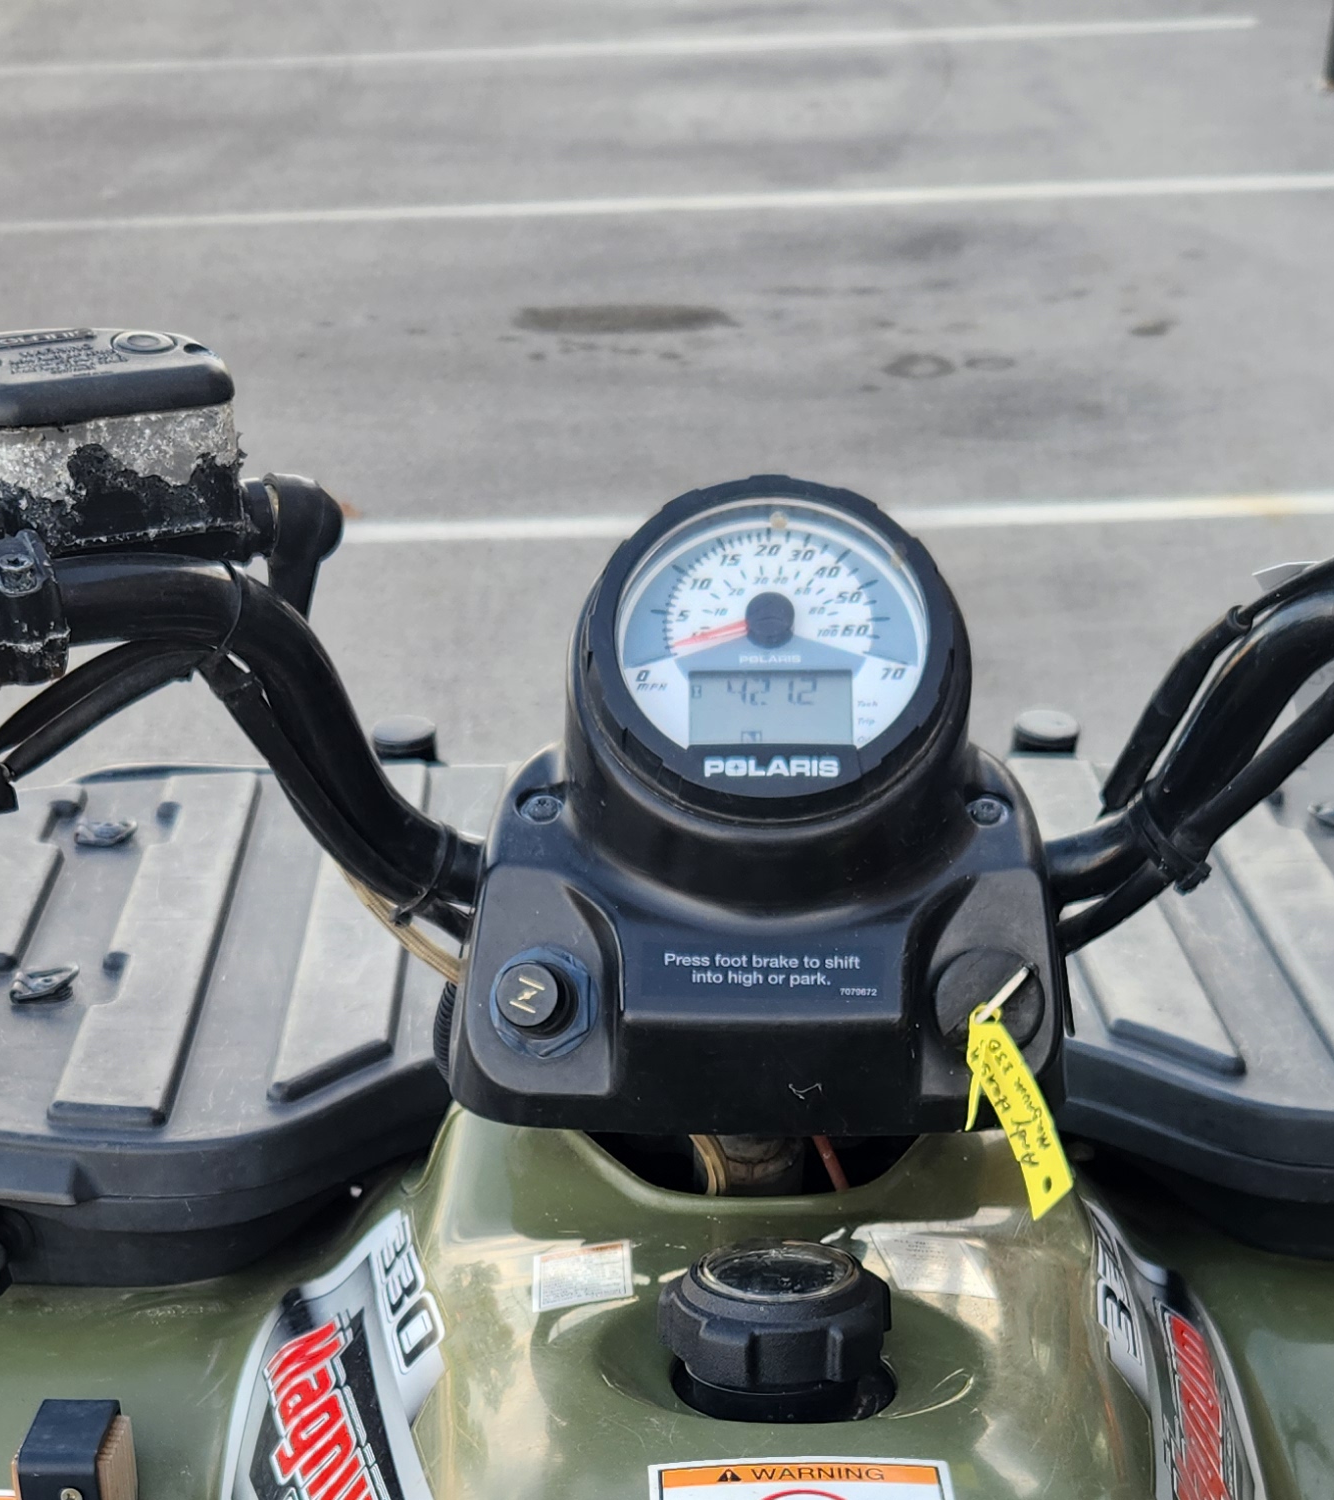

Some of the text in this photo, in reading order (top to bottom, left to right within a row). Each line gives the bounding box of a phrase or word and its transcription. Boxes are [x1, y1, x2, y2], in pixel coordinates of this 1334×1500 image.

[754, 545, 781, 556] 20
[789, 550, 815, 561] 30
[720, 554, 741, 566] 15
[815, 567, 840, 578] 40
[690, 578, 712, 590] 10
[835, 592, 862, 603] 50
[676, 611, 690, 622] 5
[841, 625, 869, 637] 60
[739, 654, 802, 664] POLARIS
[636, 670, 650, 682] 0
[881, 667, 907, 680] 70
[703, 755, 841, 778] POLARIS
[664, 953, 860, 969] Press foot brake to shift
[692, 970, 831, 987] into high or park.
[375, 1215, 446, 1375] 330
[751, 1468, 885, 1481] WARNING
